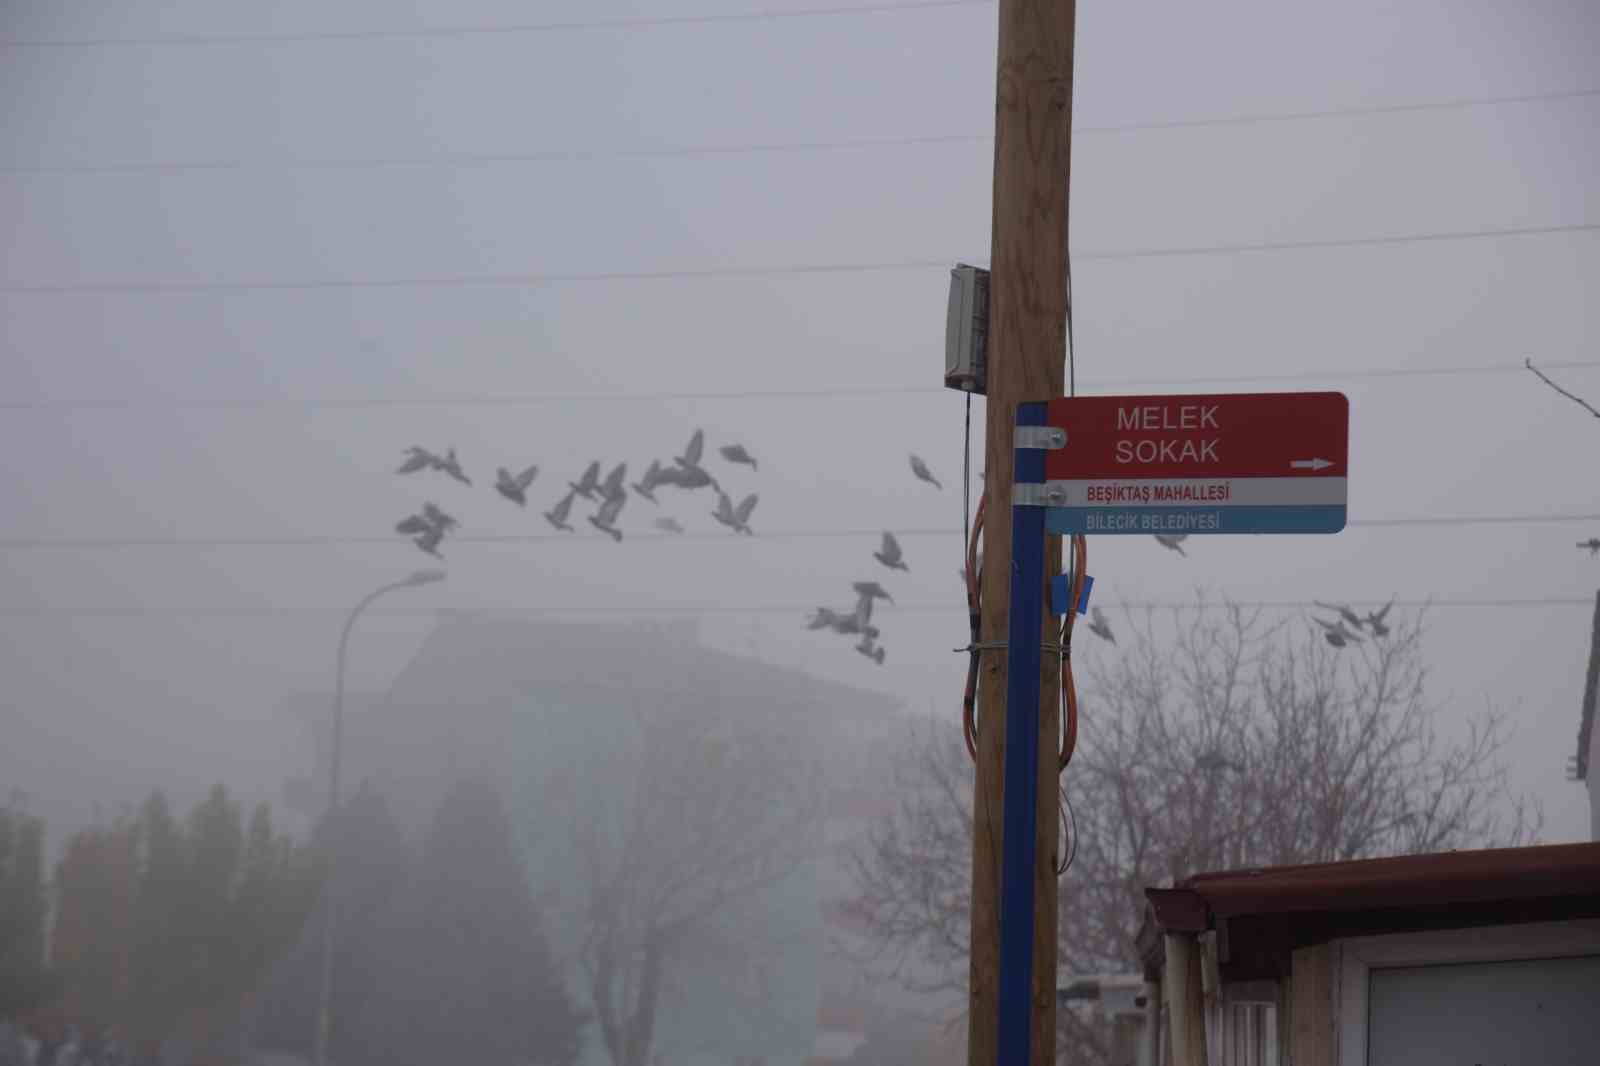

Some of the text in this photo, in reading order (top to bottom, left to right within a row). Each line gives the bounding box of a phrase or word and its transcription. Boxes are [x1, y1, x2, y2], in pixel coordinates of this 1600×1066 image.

[1117, 406, 1219, 430] MELEK
[1115, 439, 1219, 464] SOKAK
[1087, 481, 1230, 504] BEŞİKTAŞ MAHALLESİ
[1087, 510, 1220, 529] BİLECİK BELEDİYESİ
